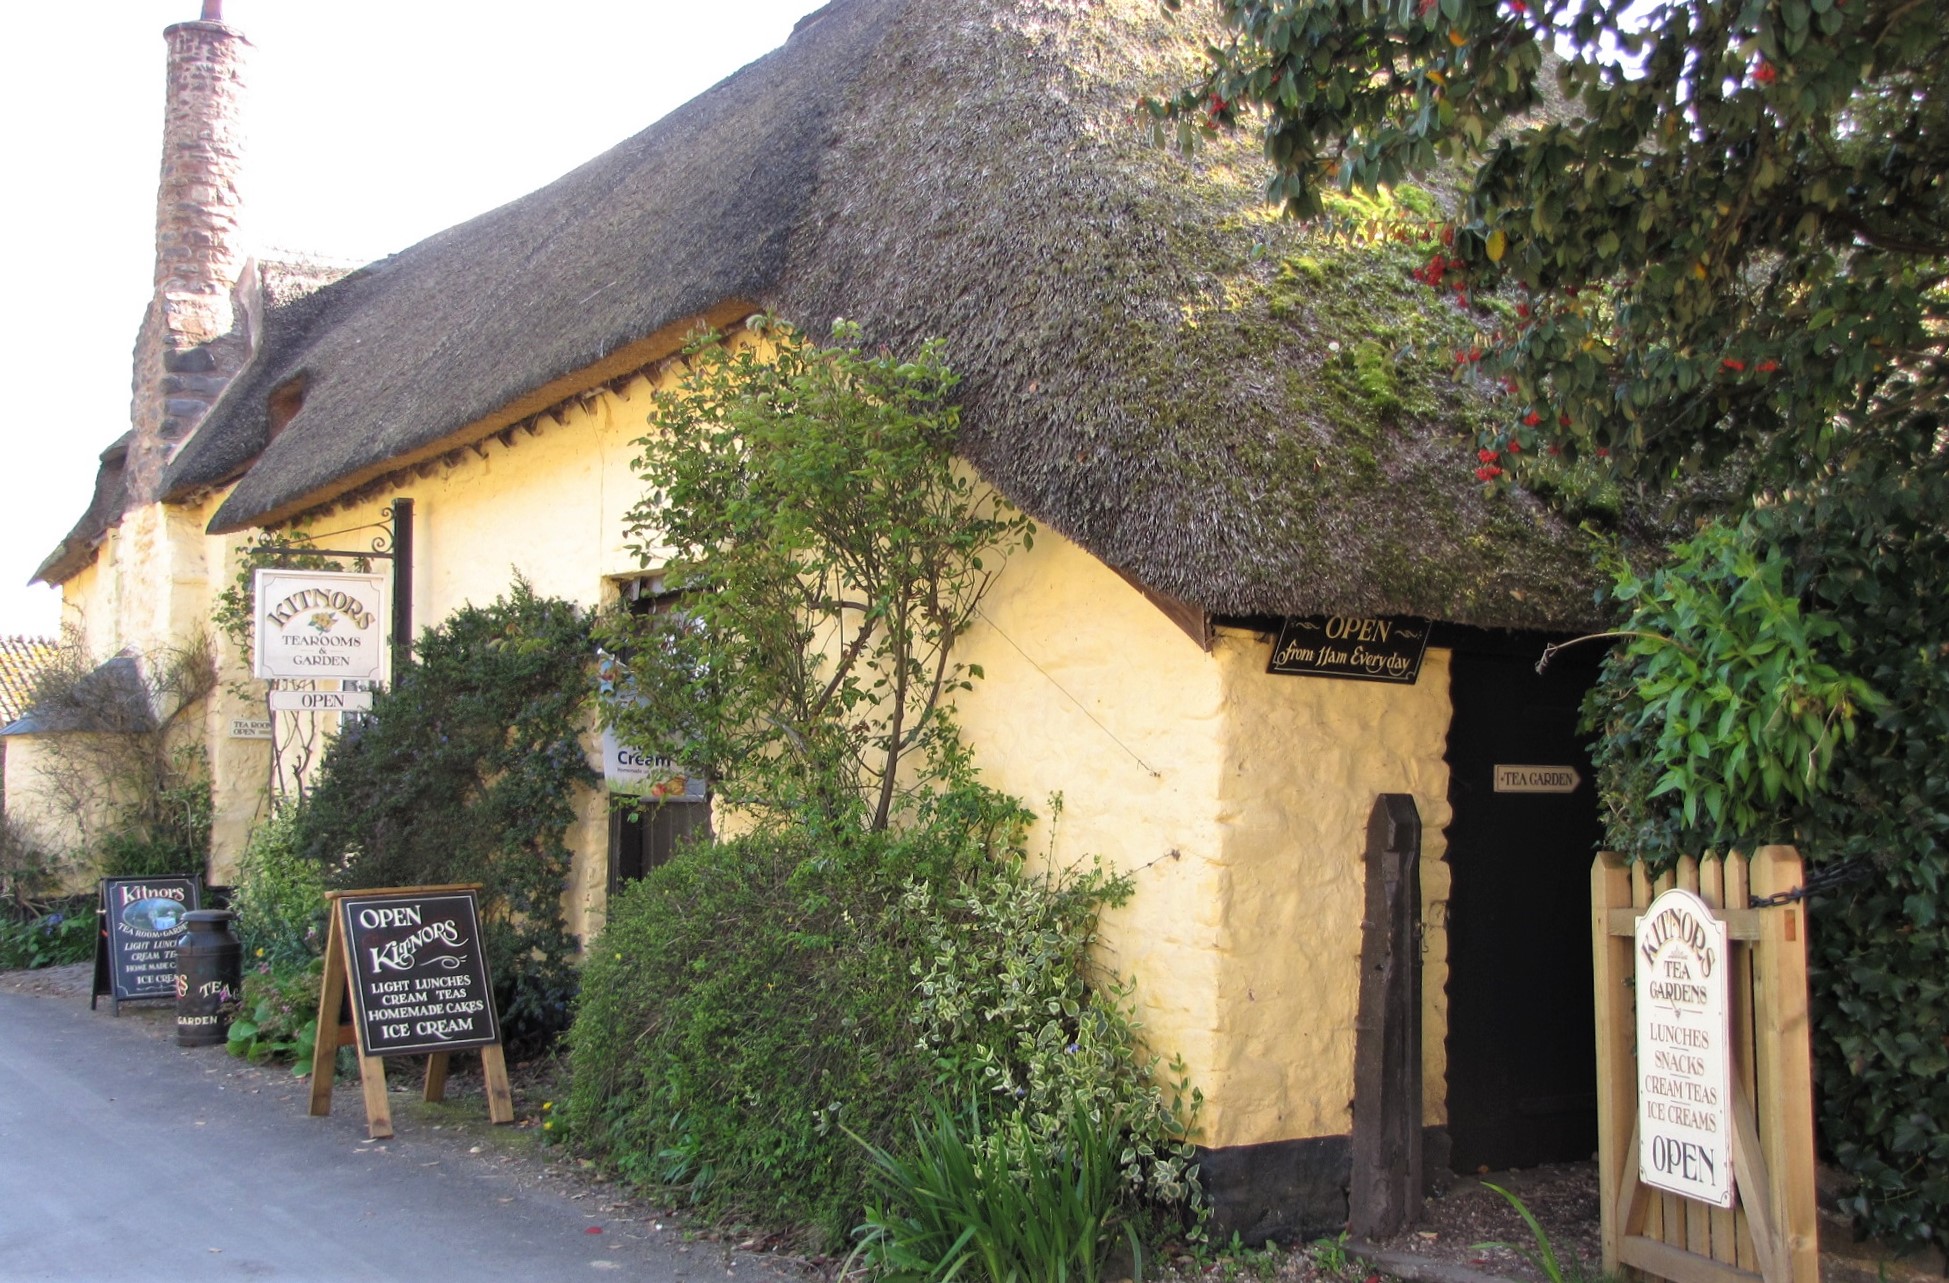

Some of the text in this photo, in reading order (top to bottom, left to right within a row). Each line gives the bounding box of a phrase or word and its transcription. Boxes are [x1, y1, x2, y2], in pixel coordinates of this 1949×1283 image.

[266, 588, 376, 630] KITNORS
[1325, 615, 1392, 643] OPEN
[282, 635, 361, 648] TEAROOMS
[293, 656, 350, 666] GARDEN
[1277, 639, 1411, 676] from 11am Everyday
[302, 694, 344, 708] OPEN
[617, 750, 671, 767] Cream
[1504, 772, 1573, 786] TEA GARDEN
[122, 886, 185, 905] Kitnors
[359, 905, 422, 929] OPEN
[118, 922, 134, 935] TEA
[124, 941, 150, 951] LIGHT
[1640, 908, 1716, 978] KITNORS
[131, 952, 160, 961] CREAM
[126, 963, 147, 972] HOME
[1663, 960, 1690, 980] TEA
[137, 975, 154, 984] ICE
[371, 975, 471, 994] LIGHT LUNCHES
[382, 988, 467, 1006] CREAM TEAS
[1650, 981, 1707, 1005] GARDENS
[177, 1015, 218, 1025] GARDEN
[368, 1000, 484, 1022] HOMEMADE CAKES
[382, 1017, 473, 1040] ICE CREAM
[1650, 1022, 1709, 1049] LUNCHES
[1654, 1050, 1705, 1077] SNACKS
[1645, 1075, 1717, 1106] CREAM TEAS
[1647, 1100, 1717, 1133] ICE CREAMS
[1652, 1135, 1717, 1187] OPEN
